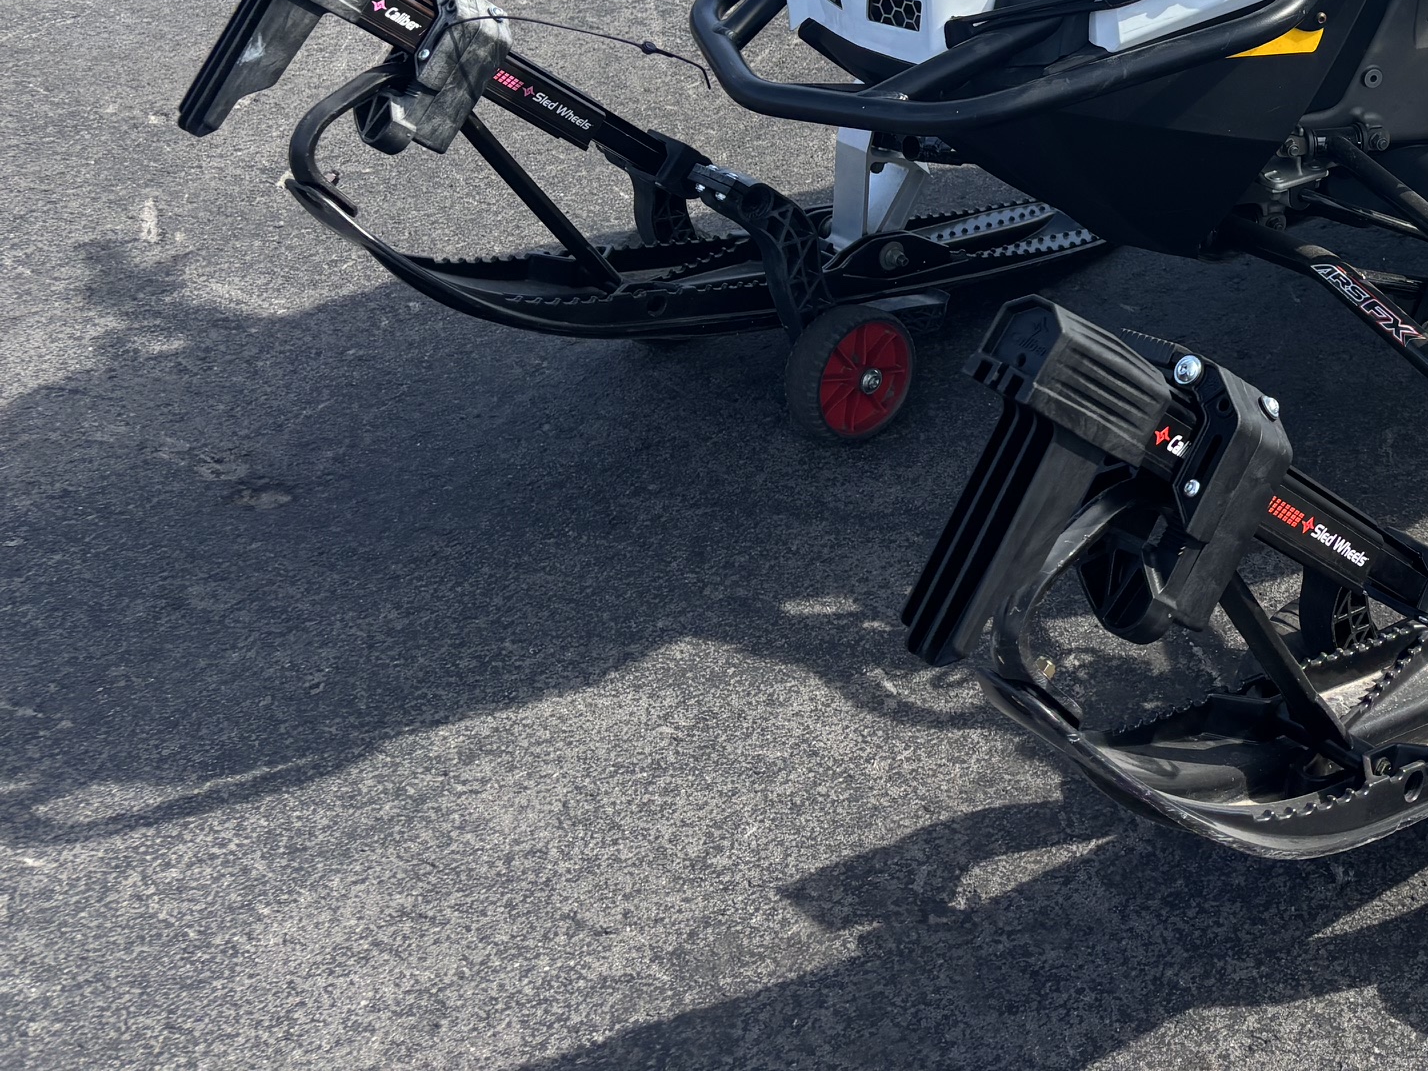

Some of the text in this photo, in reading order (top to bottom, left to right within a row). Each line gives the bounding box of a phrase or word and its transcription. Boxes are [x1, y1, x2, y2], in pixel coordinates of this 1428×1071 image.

[385, 7, 420, 31] Caliber
[532, 91, 592, 130] Sled Wheels
[1310, 523, 1367, 567] Sled Wheels
